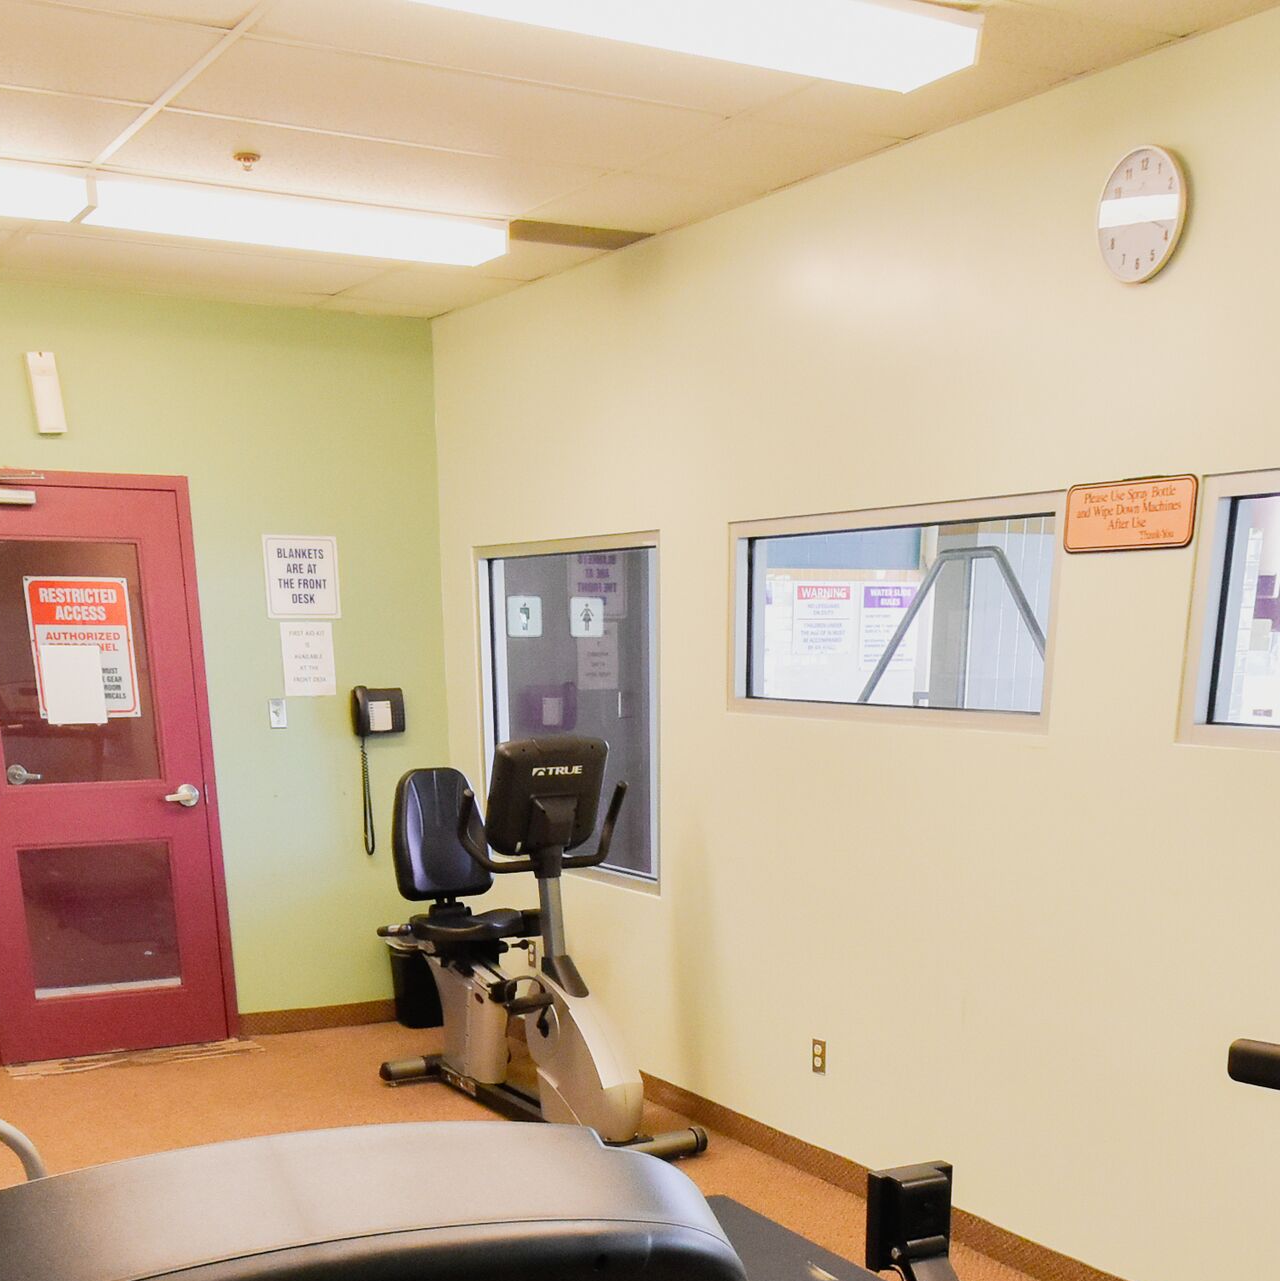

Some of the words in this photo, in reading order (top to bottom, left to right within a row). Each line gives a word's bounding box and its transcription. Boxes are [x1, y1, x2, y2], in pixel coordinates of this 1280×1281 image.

[1141, 157, 1150, 171] 12
[1125, 168, 1133, 180] 11
[1168, 177, 1174, 190] 2
[1084, 492, 1109, 504] Please
[1111, 490, 1125, 501] Use
[1127, 489, 1148, 502] Spray
[1151, 485, 1177, 498] Bottle
[1077, 507, 1091, 518] and
[1093, 505, 1113, 519] Wipe
[1116, 504, 1140, 515] Down
[1142, 501, 1182, 513] Machines
[1109, 518, 1129, 530] After
[1132, 517, 1146, 528] Use
[1139, 530, 1160, 539] Thank
[1161, 529, 1174, 538] You
[276, 548, 324, 559] BLANKETS
[286, 563, 304, 574] ARE
[307, 563, 317, 574] AT
[278, 578, 295, 589] THE
[298, 578, 327, 589] FRONT
[38, 587, 117, 604] RESTRICTED
[291, 593, 315, 604] DESK
[801, 587, 848, 600] WARNING
[870, 588, 892, 597] WATER
[55, 605, 107, 621] ACCESS
[45, 631, 121, 641] AUTHORIZED
[547, 764, 583, 776] TRUE
